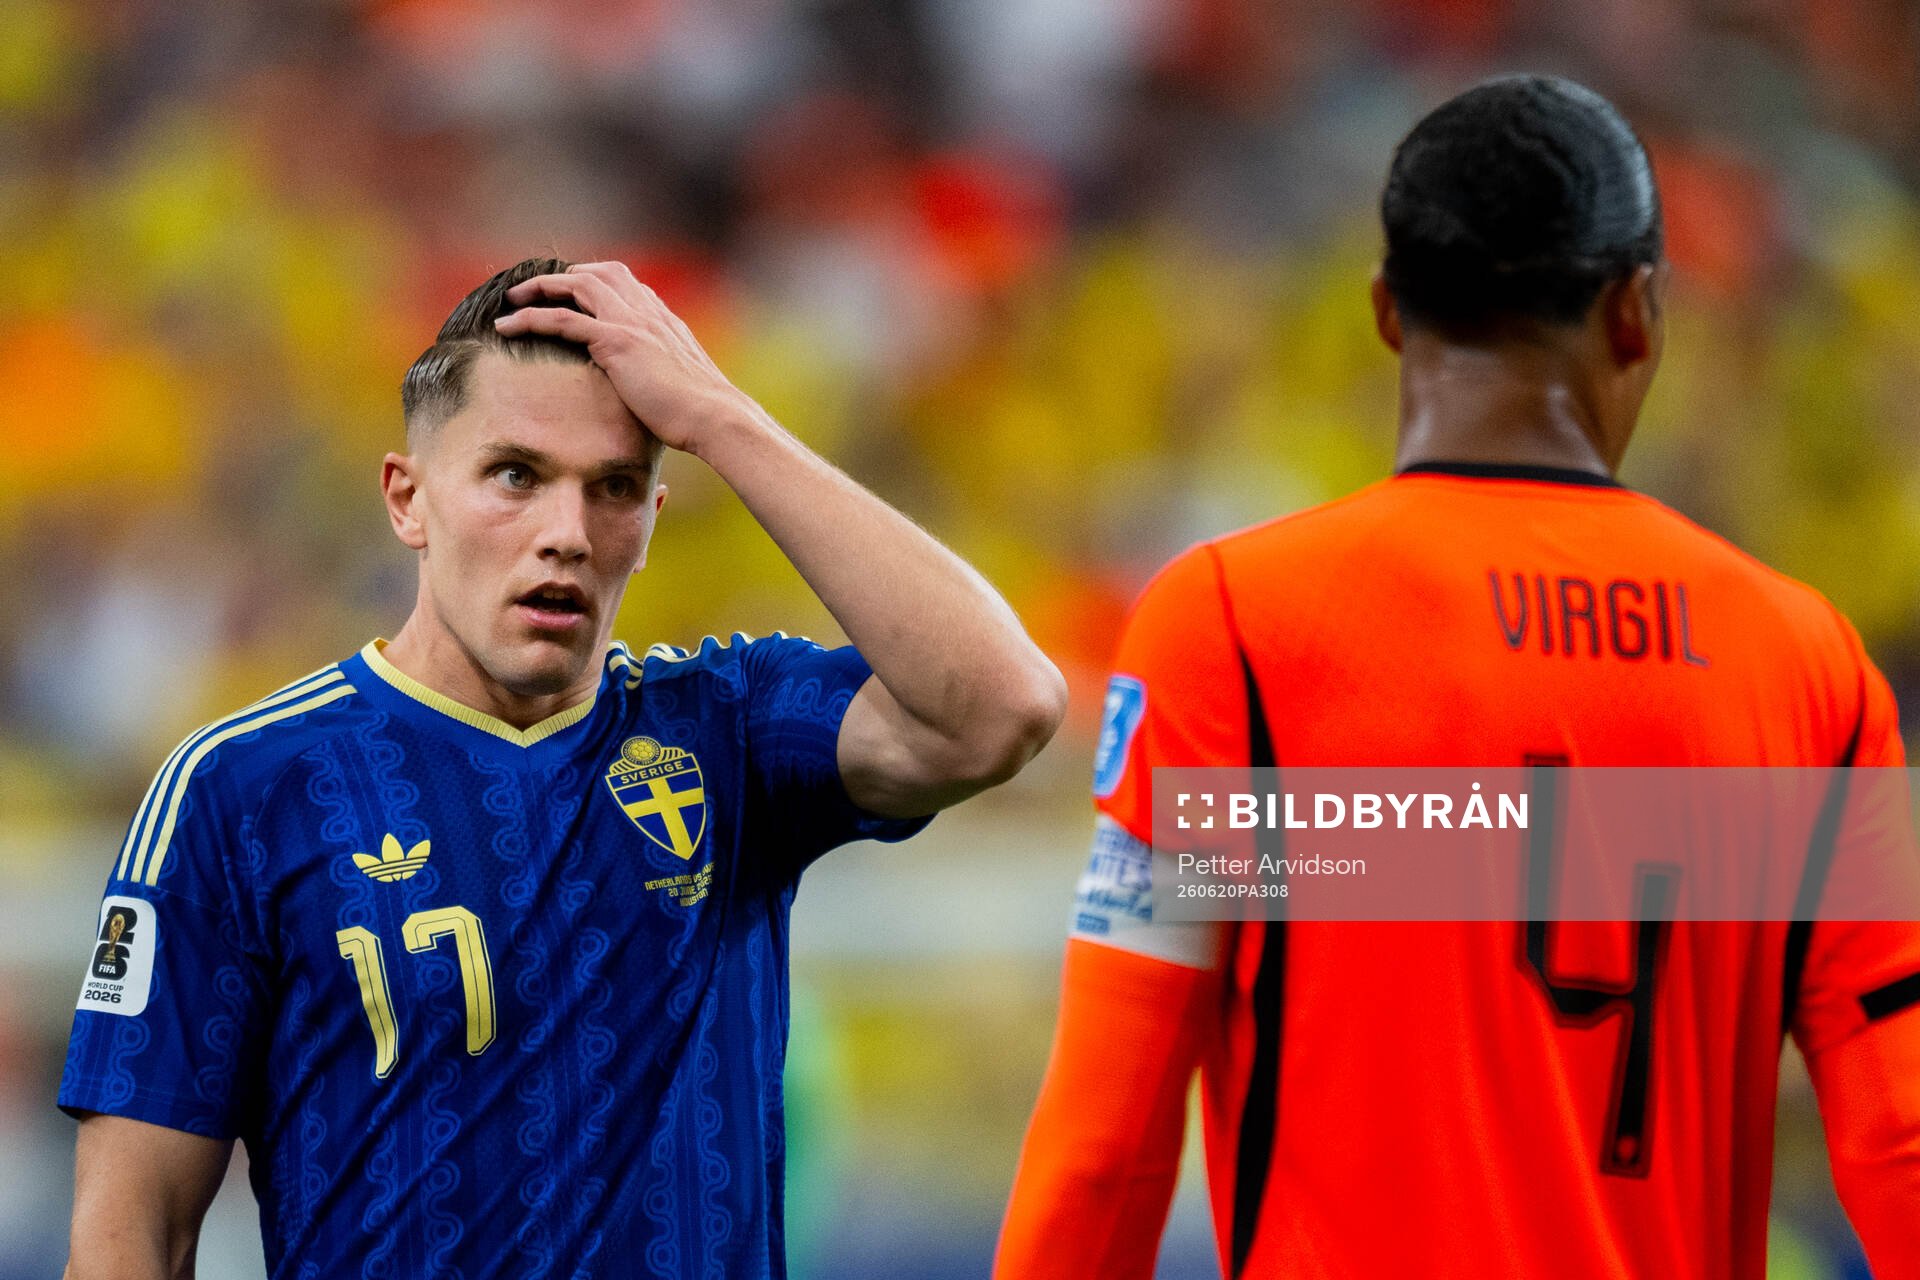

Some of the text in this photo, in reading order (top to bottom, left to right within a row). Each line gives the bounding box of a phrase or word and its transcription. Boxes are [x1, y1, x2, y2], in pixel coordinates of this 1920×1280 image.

[1489, 571, 1710, 668] VIRGIL
[620, 760, 685, 785] SVERIGE
[668, 887, 679, 897] 20
[98, 964, 116, 975] FIFA
[1515, 752, 1683, 1180] 4
[84, 989, 122, 1004] 2026
[87, 981, 124, 992] WORLD CUP
[335, 905, 497, 1079] 17
